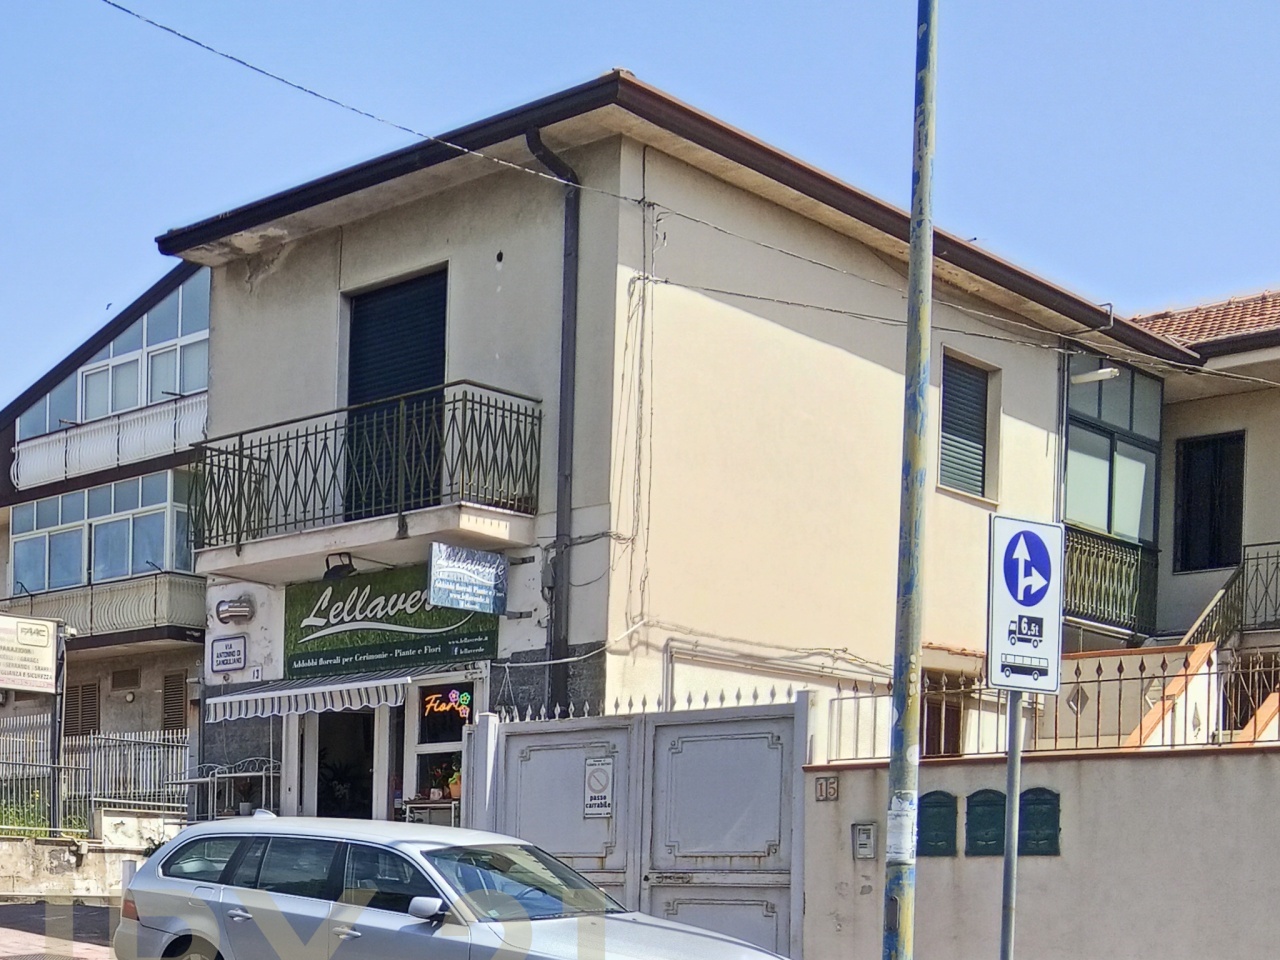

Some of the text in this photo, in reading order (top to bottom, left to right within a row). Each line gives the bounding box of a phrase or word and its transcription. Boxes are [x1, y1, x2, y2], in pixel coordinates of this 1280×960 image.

[436, 547, 505, 575] Lellaverde
[292, 657, 318, 669] Addobbi
[318, 655, 340, 666] floreali
[342, 655, 354, 665] per
[354, 651, 388, 662] Cerimonie
[394, 648, 416, 657] Piante
[424, 646, 441, 654] Fiori
[425, 694, 460, 716] Fiori
[818, 782, 836, 797] 15
[585, 801, 611, 809] carrabile
